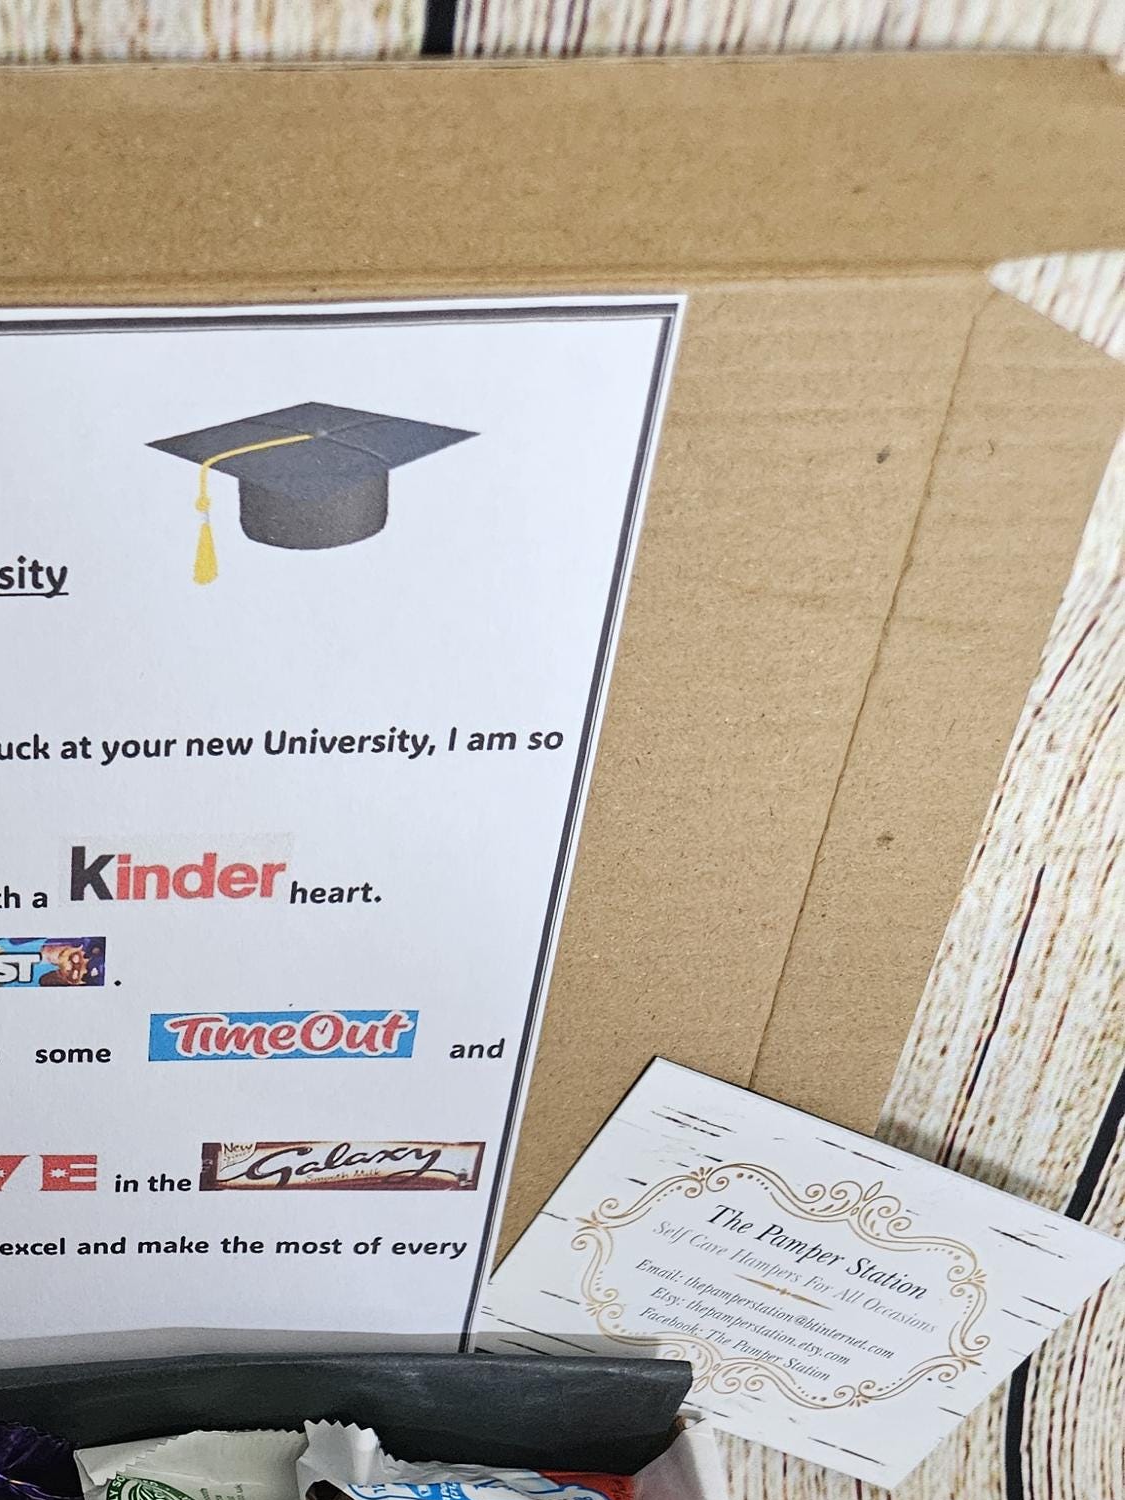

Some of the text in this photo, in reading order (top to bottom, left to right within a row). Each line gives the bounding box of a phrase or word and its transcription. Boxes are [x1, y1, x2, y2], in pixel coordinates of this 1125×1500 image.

[60, 735, 93, 760] at
[100, 738, 178, 767] your
[185, 736, 254, 757] new
[263, 725, 436, 760] University,
[447, 726, 458, 752] I
[466, 731, 517, 752] am
[526, 731, 564, 751] so
[31, 891, 48, 909] a
[289, 880, 383, 905] heart.
[34, 1047, 112, 1065] some
[449, 1037, 506, 1060] and
[114, 1173, 139, 1193] in
[146, 1172, 192, 1193] the
[243, 1142, 445, 1188] Galaxy
[76, 1236, 127, 1256] and
[137, 1235, 210, 1254] make
[219, 1235, 265, 1255] the
[275, 1238, 343, 1255] most
[352, 1236, 383, 1256] of
[391, 1241, 468, 1260] every
[652, 1220, 939, 1335] Self Care Hampers For All Occasions
[707, 1204, 928, 1300] The Pamper Station
[635, 1258, 895, 1360] Email: thepamperstation@btinternet.com
[650, 1286, 852, 1367] Etsy: thepamperstation.etsy.com
[638, 1306, 831, 1382] Facebook: The Pamper Station
